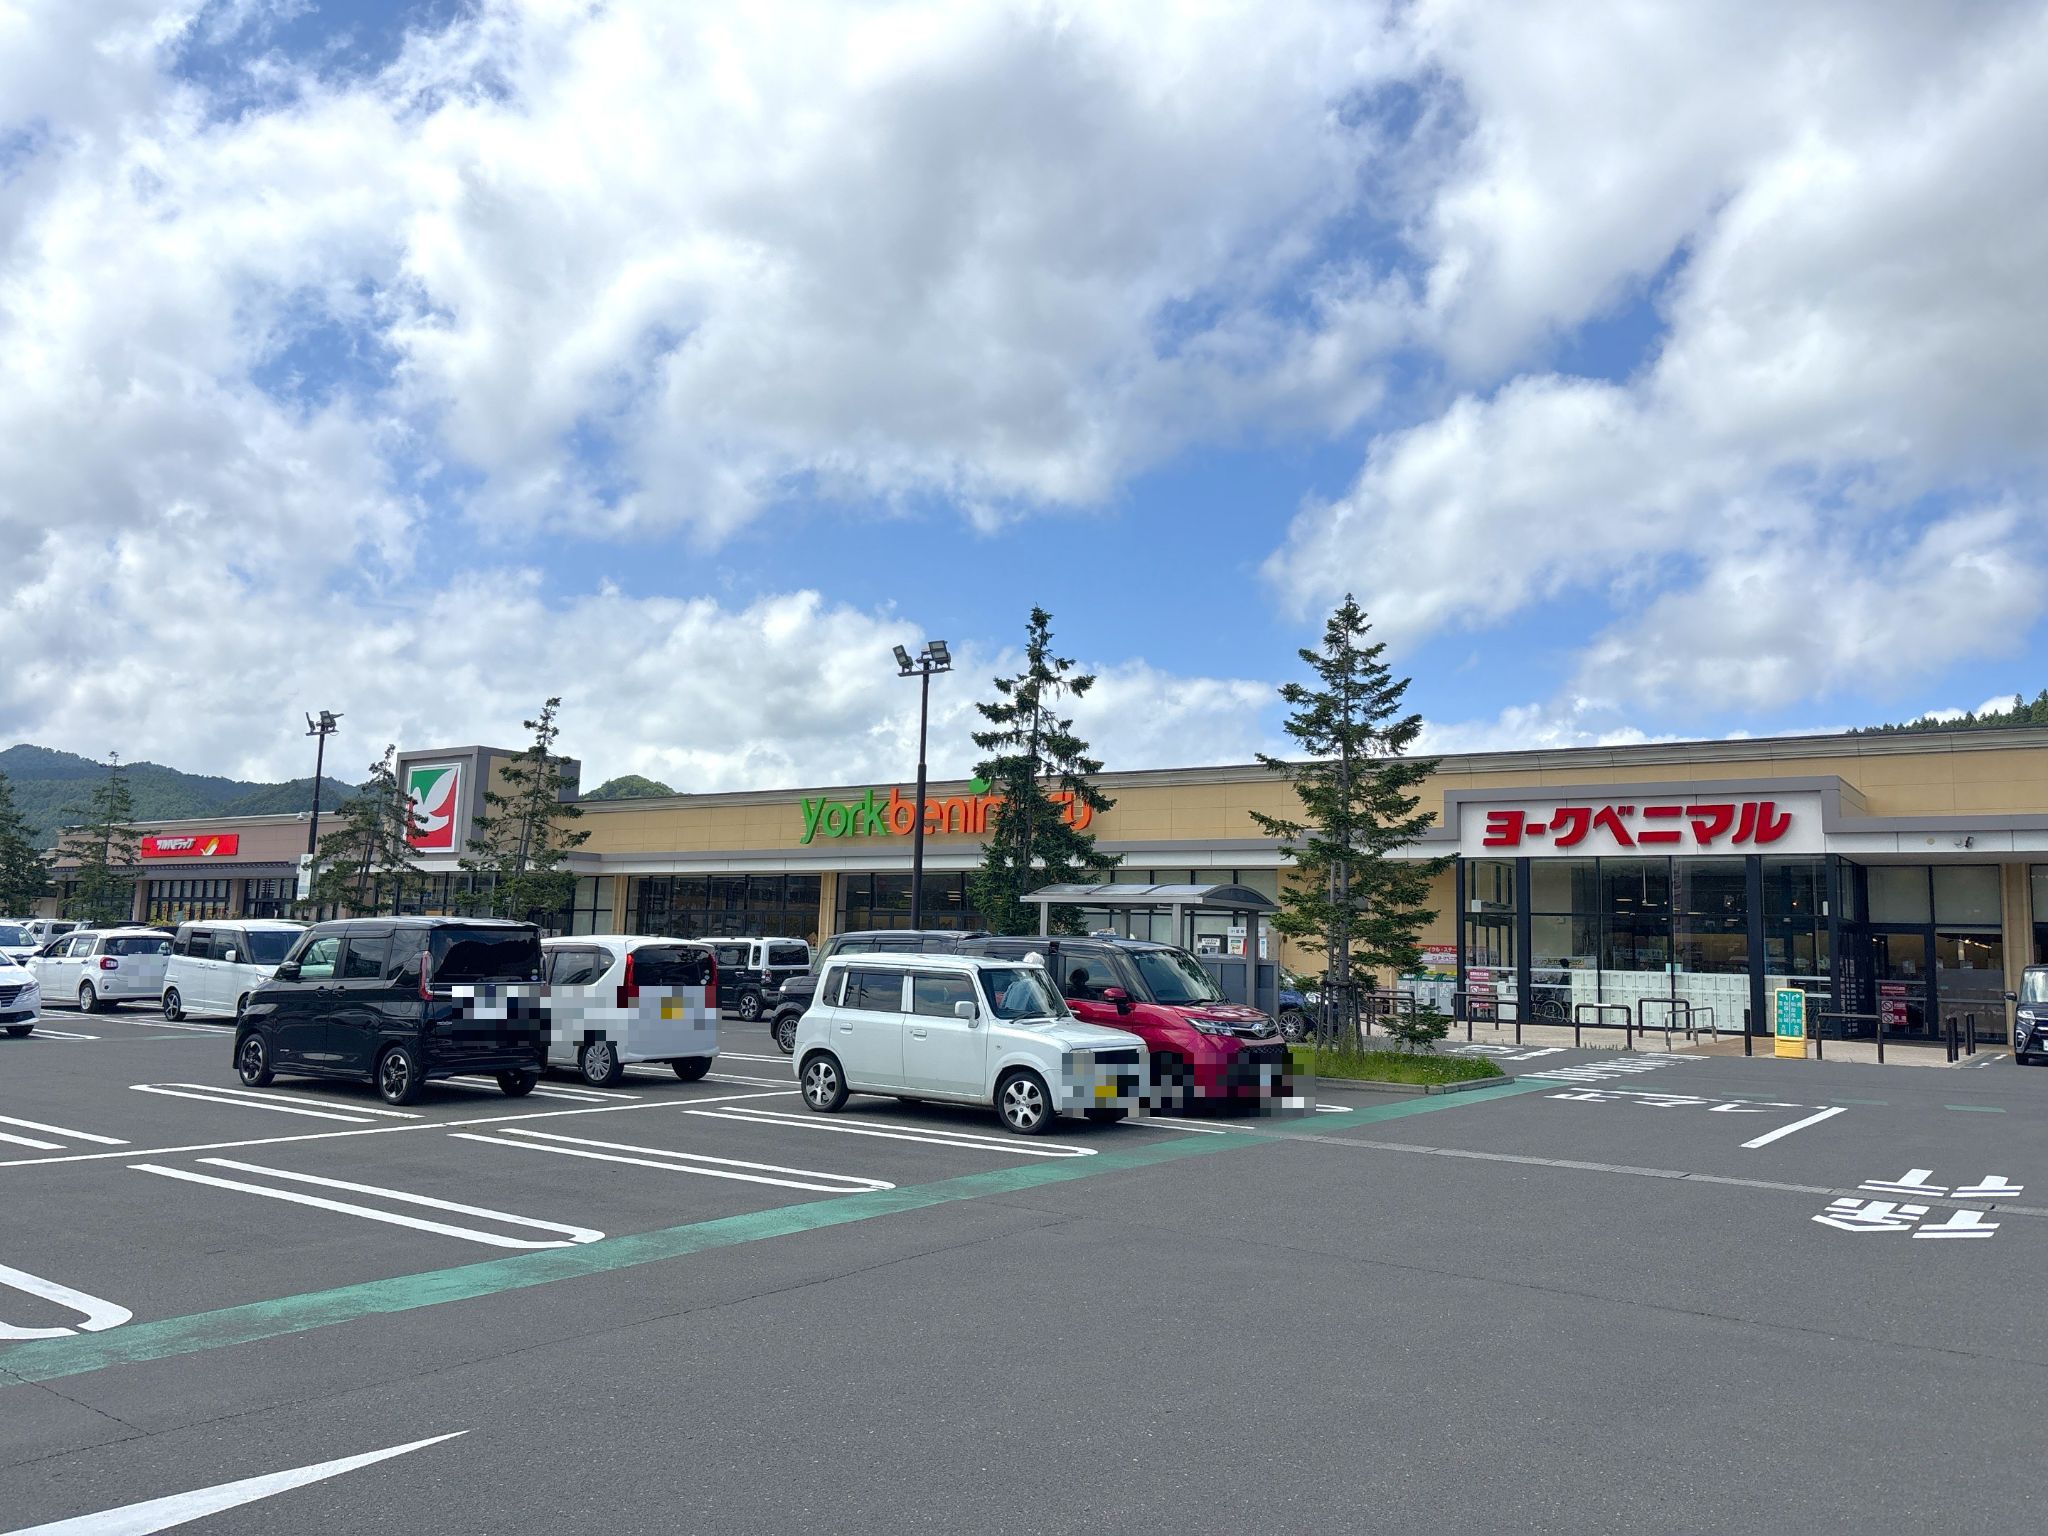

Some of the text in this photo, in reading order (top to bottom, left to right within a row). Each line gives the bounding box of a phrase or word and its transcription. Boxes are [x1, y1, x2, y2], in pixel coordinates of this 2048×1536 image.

[1483, 802, 1792, 847] ヨークベニマル
